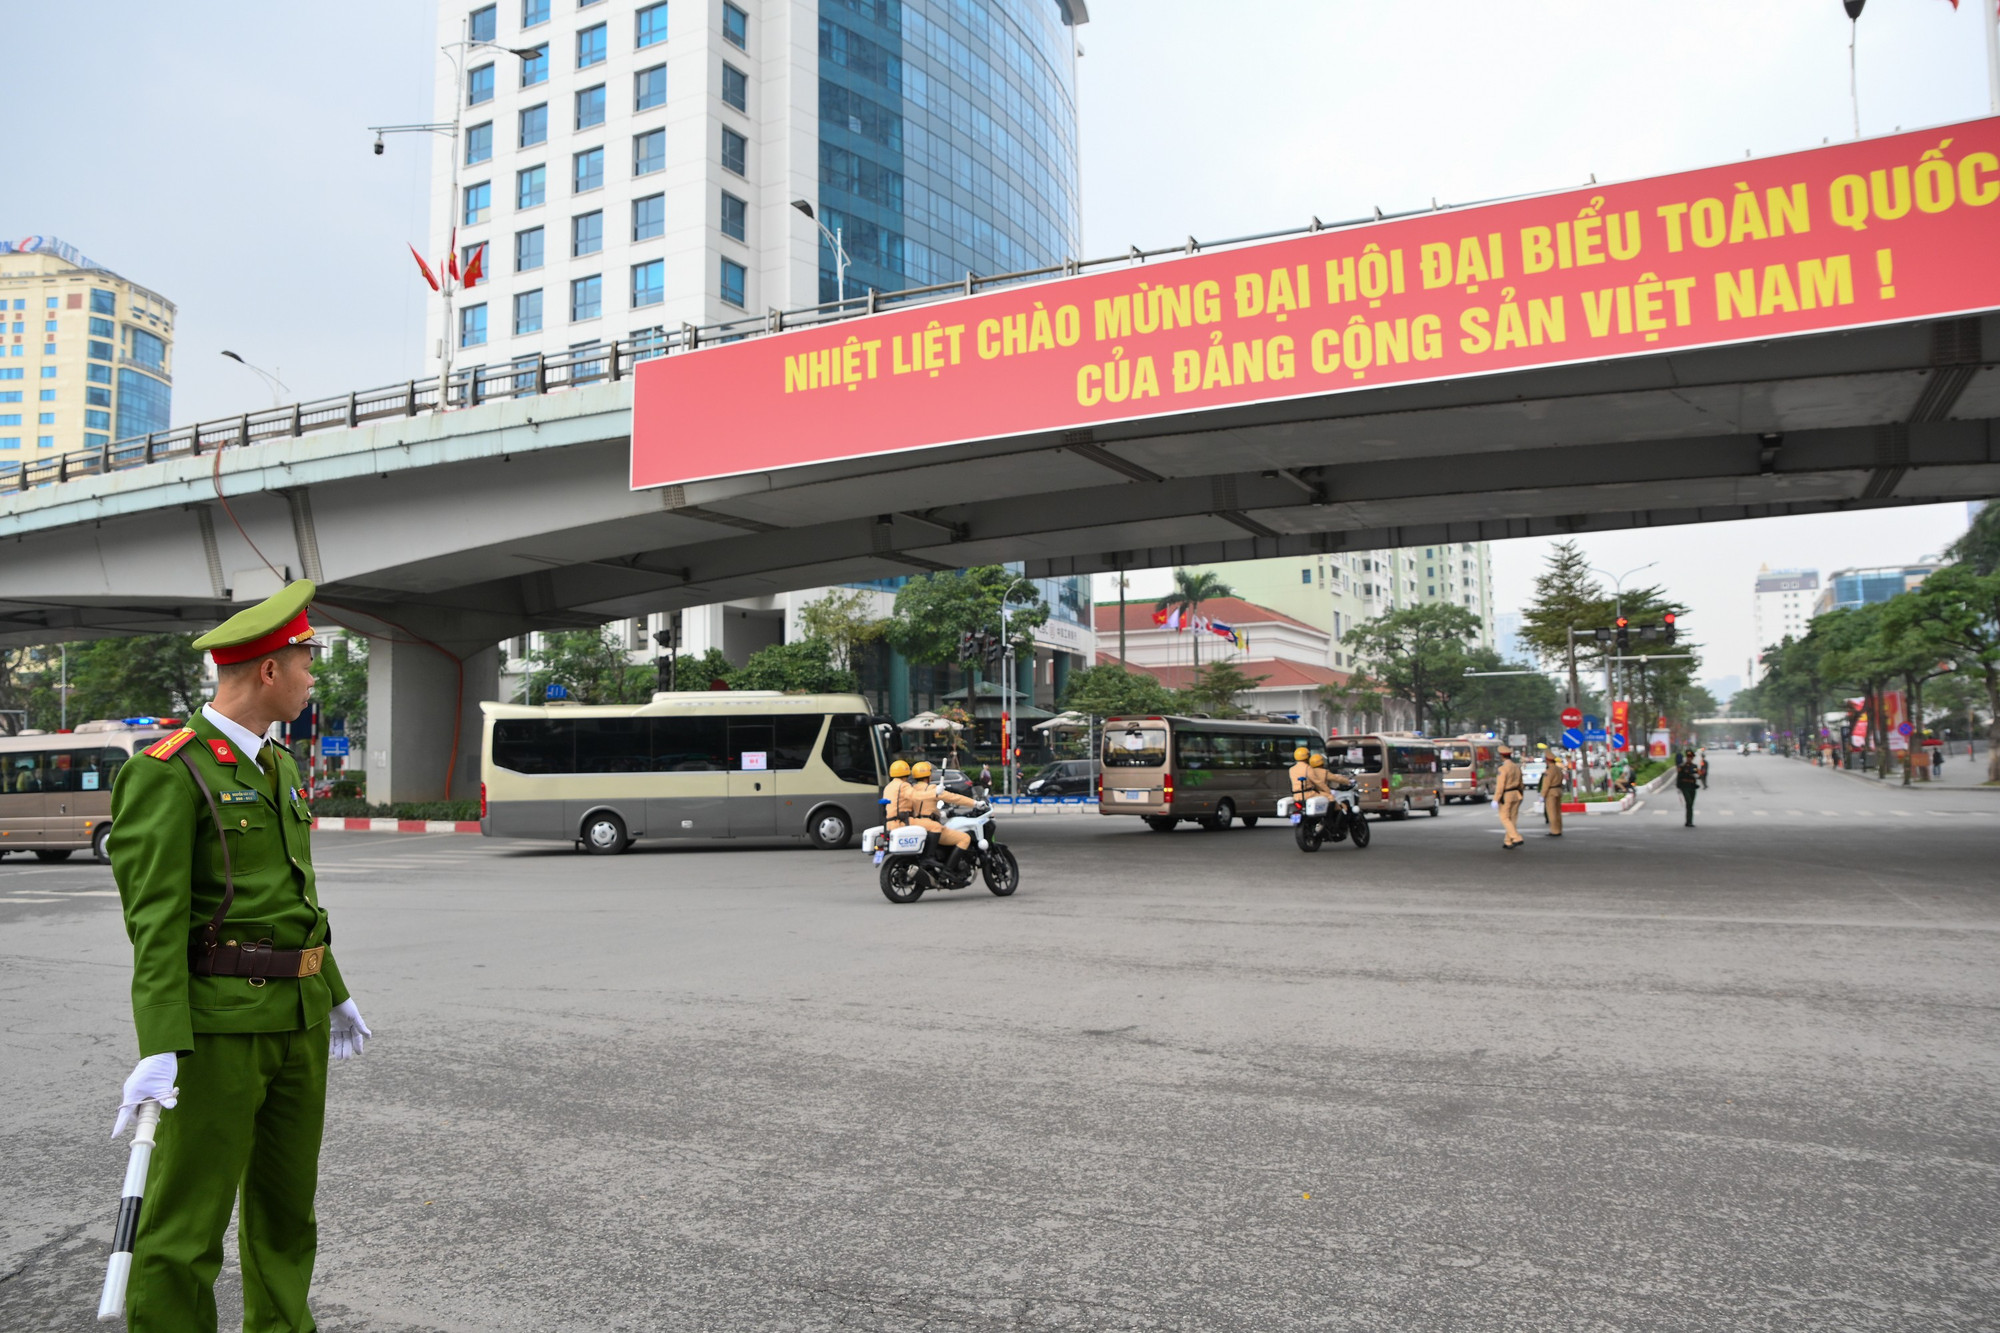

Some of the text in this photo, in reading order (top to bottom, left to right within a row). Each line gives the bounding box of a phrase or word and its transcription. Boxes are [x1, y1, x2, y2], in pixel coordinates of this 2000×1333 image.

[785, 139, 2000, 393] NHIỆT LIỆT CHÀO MỪNG ĐẠI HỘI ĐẠI BIỂU TOÀN QUỐC
[1077, 249, 1895, 407] CỦA ĐẢNG CỘNG SẢN VIỆT NAM !
[898, 837, 918, 845] CSGT
